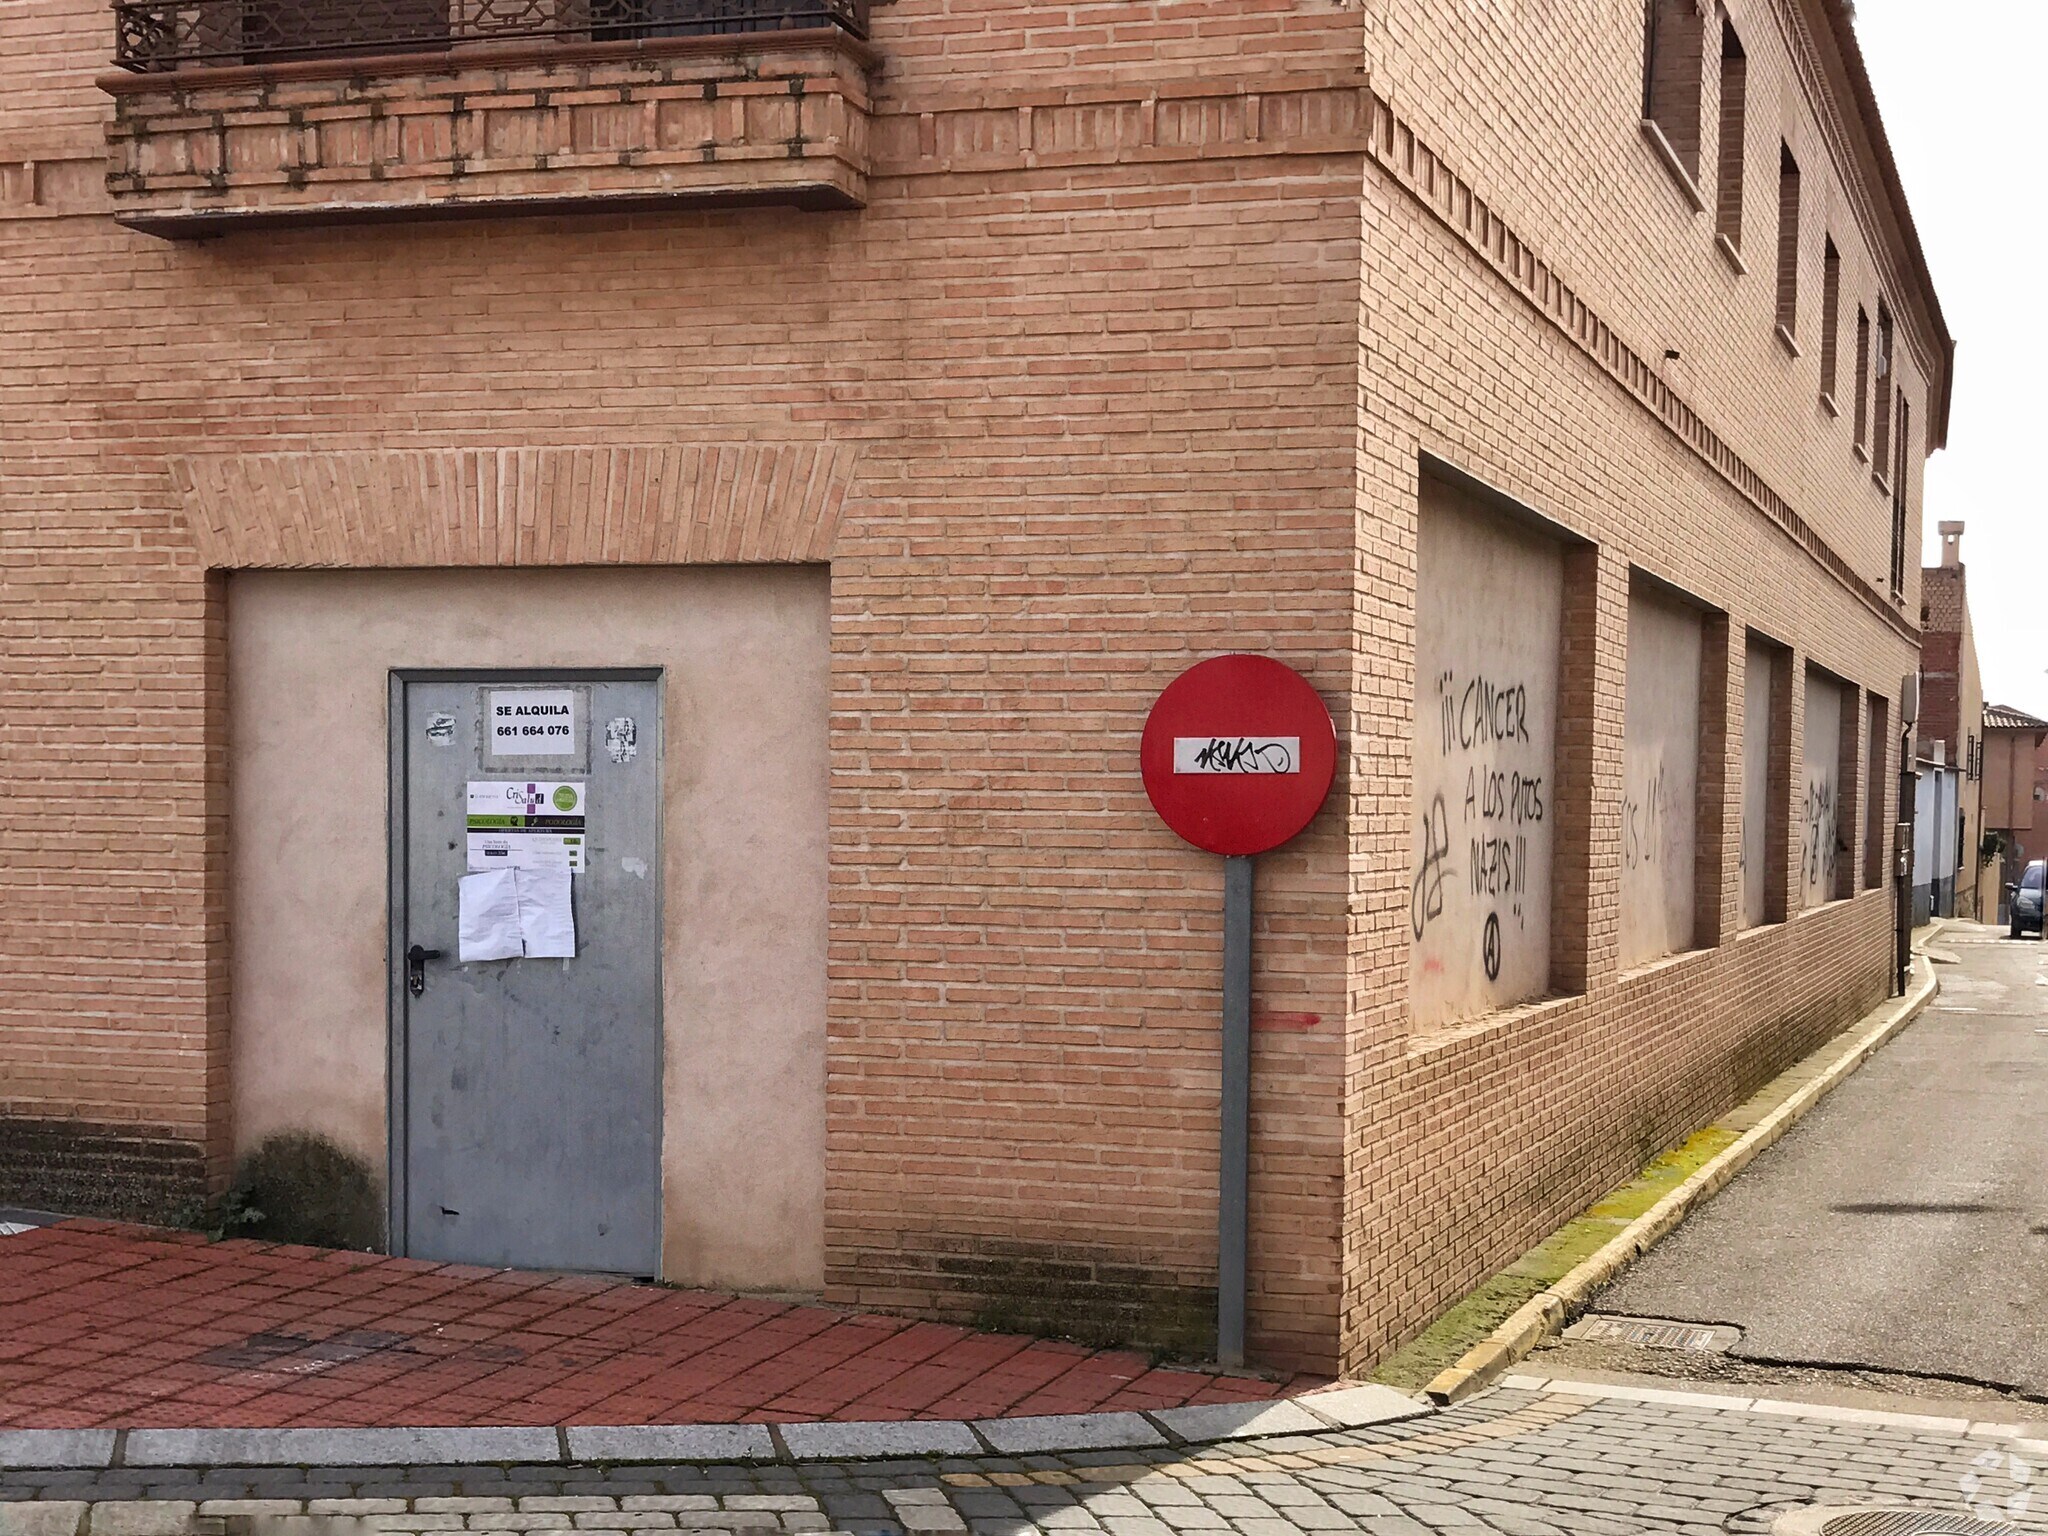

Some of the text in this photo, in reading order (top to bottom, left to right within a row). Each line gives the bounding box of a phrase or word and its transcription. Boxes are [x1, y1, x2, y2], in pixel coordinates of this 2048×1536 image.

[496, 705, 569, 716] SE ALQUILA
[497, 725, 569, 736] 661 664 076
[1464, 764, 1543, 825] A LOS PUTOS
